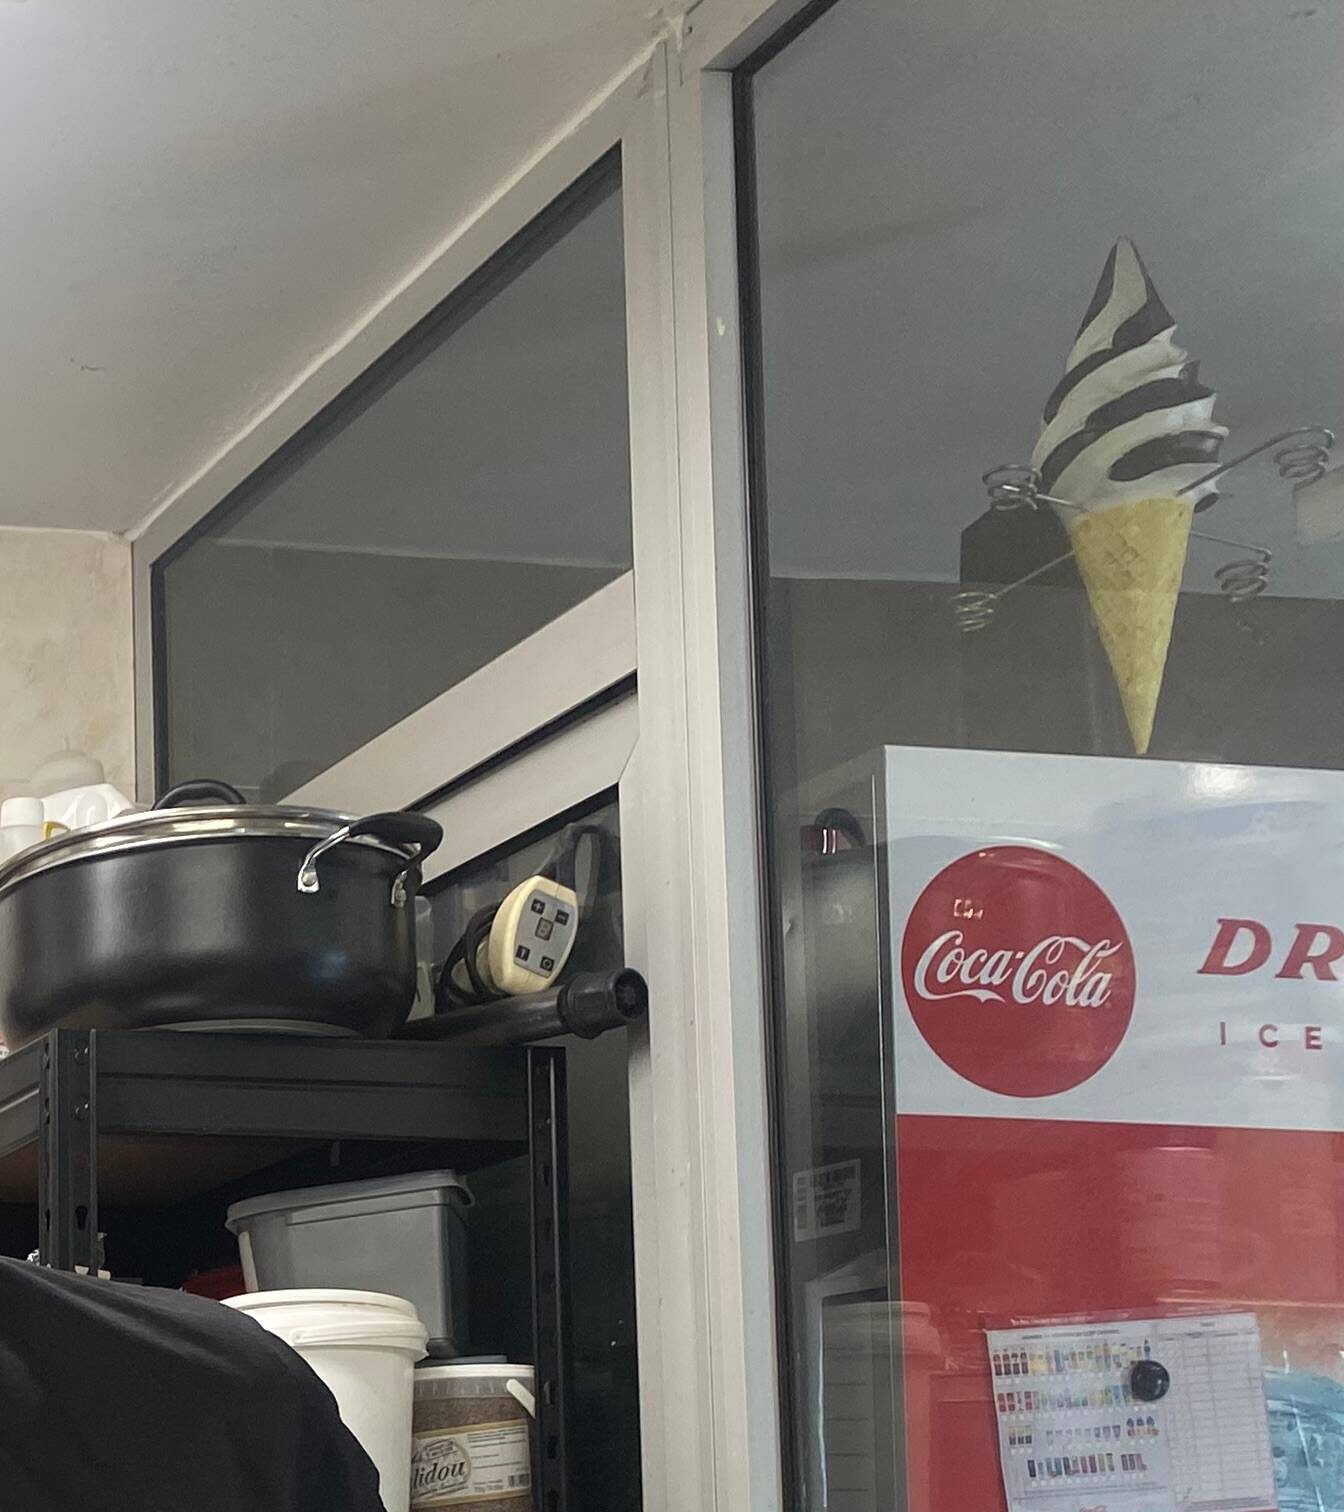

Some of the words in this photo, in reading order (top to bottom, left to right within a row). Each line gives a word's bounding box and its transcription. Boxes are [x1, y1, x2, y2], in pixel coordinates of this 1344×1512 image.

[914, 929, 1124, 1008] Coca-Cola
[1197, 918, 1344, 982] DR
[1219, 1021, 1323, 1051] ICE
